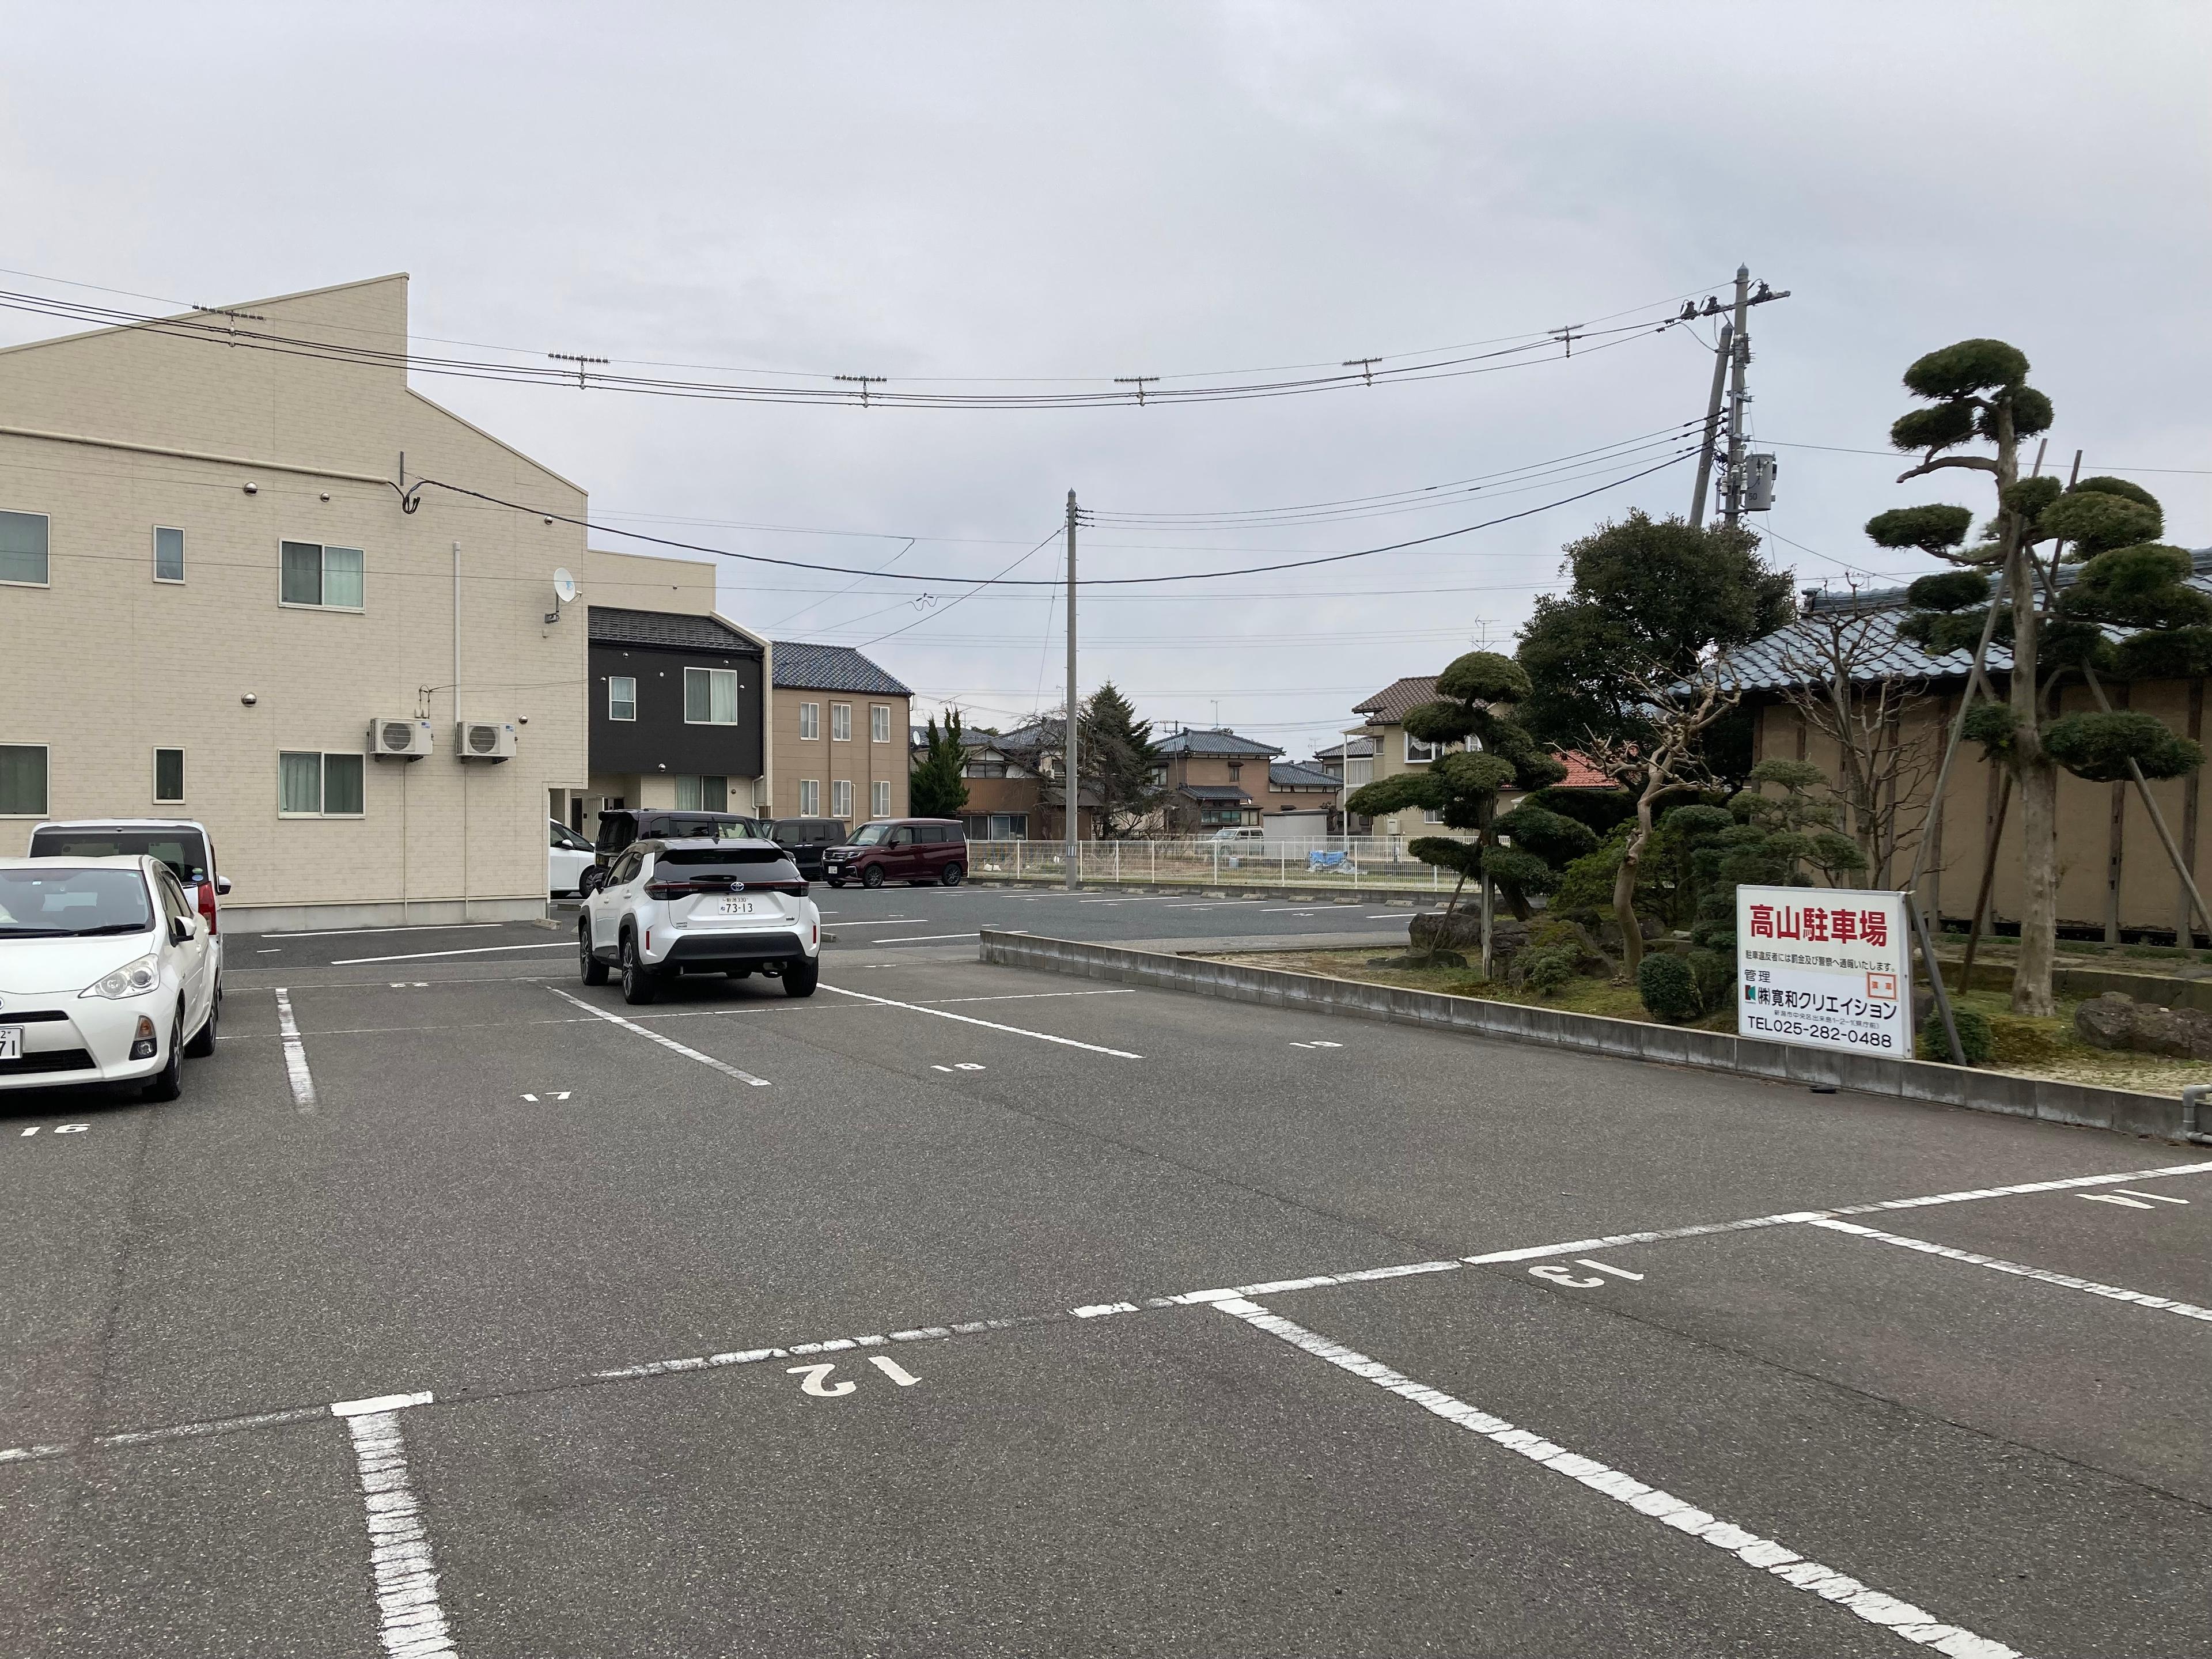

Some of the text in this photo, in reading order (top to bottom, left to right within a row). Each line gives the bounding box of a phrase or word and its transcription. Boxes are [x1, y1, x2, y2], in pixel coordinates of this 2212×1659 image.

[726, 903, 753, 913] 73-13
[1750, 904, 1888, 947] 高山駐車場
[1744, 969, 1771, 983] 管理
[1748, 1016, 1892, 1048] TEL025-282-0488
[930, 1063, 986, 1072] 18
[520, 1092, 572, 1101] 17
[21, 1123, 91, 1137] 16
[1528, 1259, 1644, 1288] 13
[786, 1355, 923, 1397] 12
